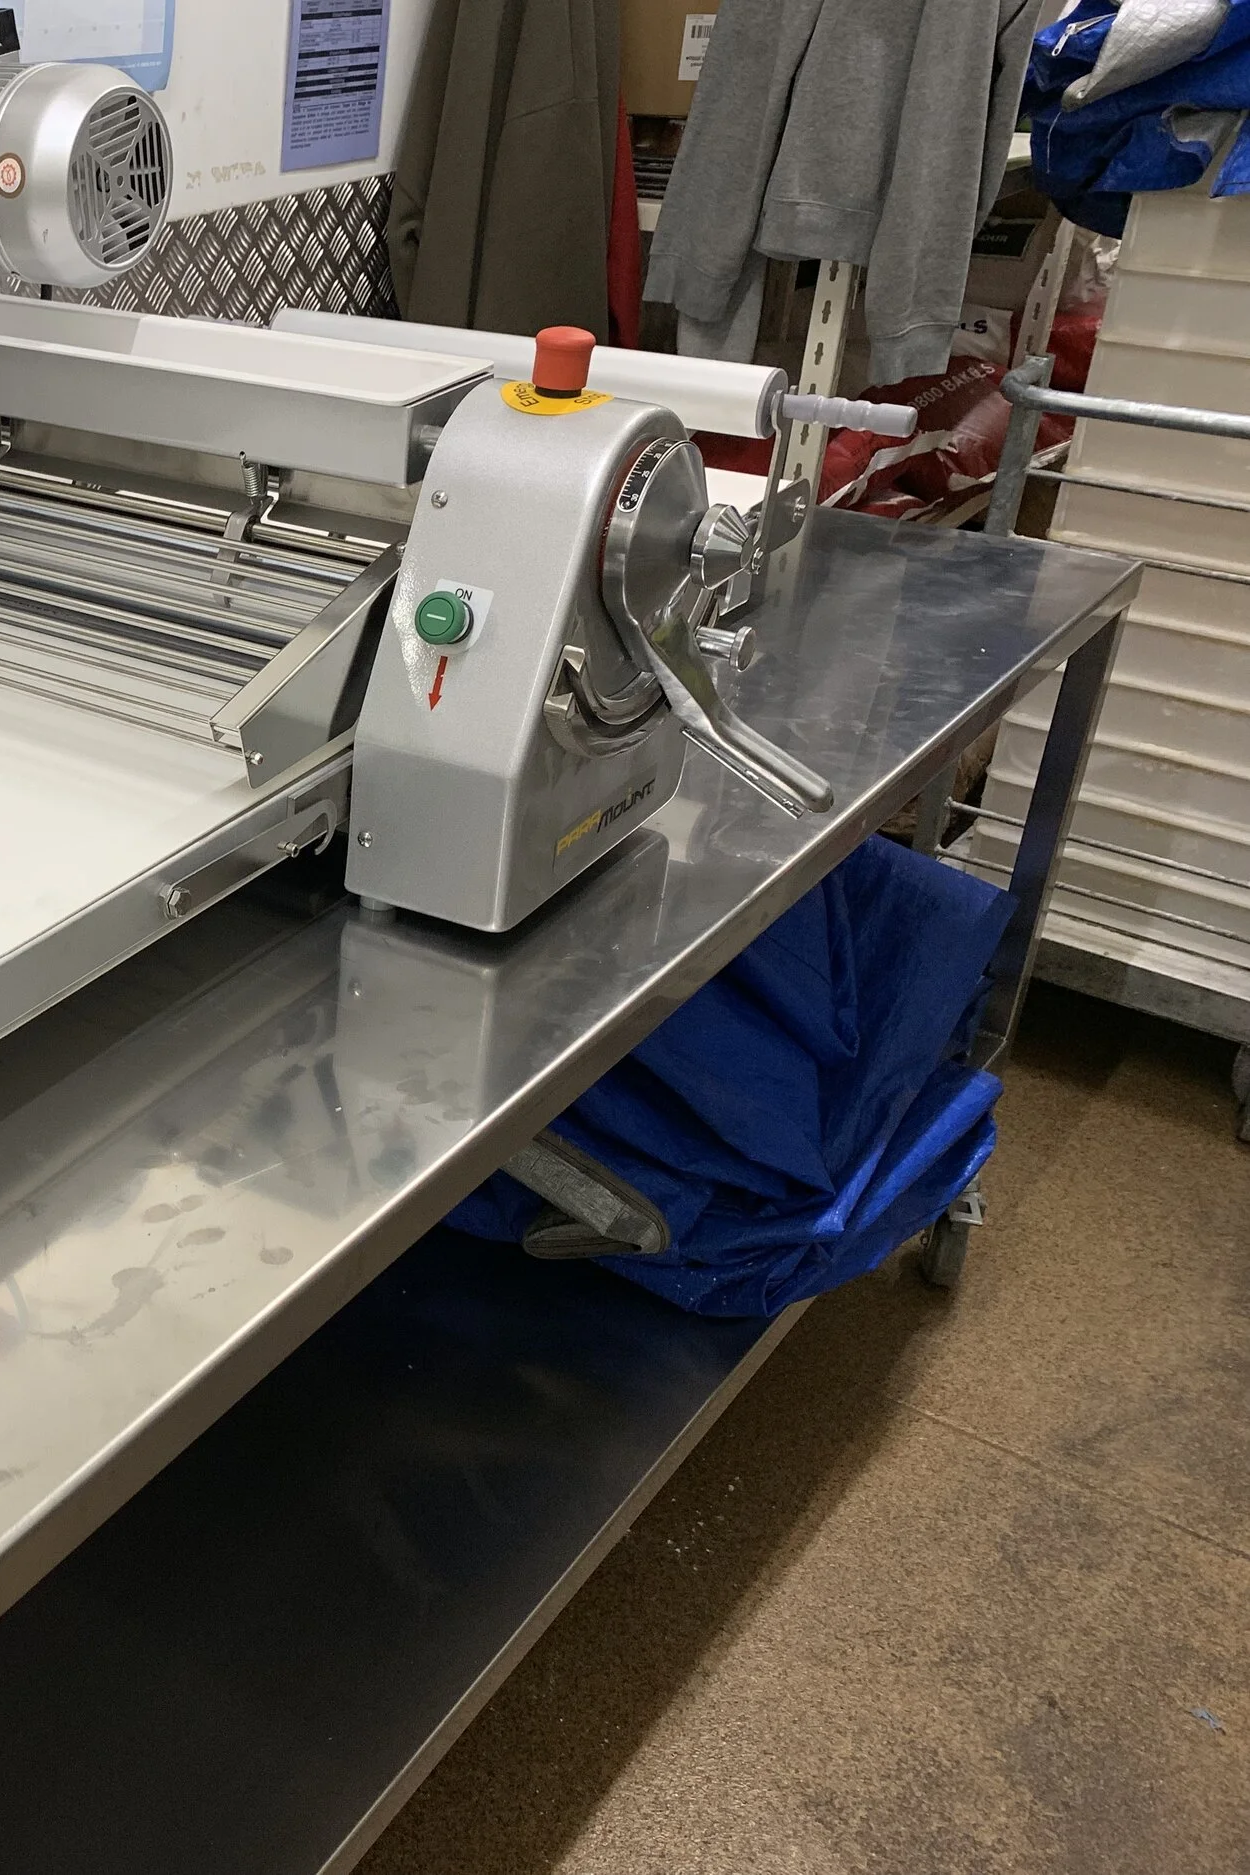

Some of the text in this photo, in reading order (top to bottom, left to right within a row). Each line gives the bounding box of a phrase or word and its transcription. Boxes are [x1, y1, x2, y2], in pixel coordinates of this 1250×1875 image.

[641, 470, 650, 478] 25
[630, 493, 640, 502] 30
[455, 588, 473, 602] ON
